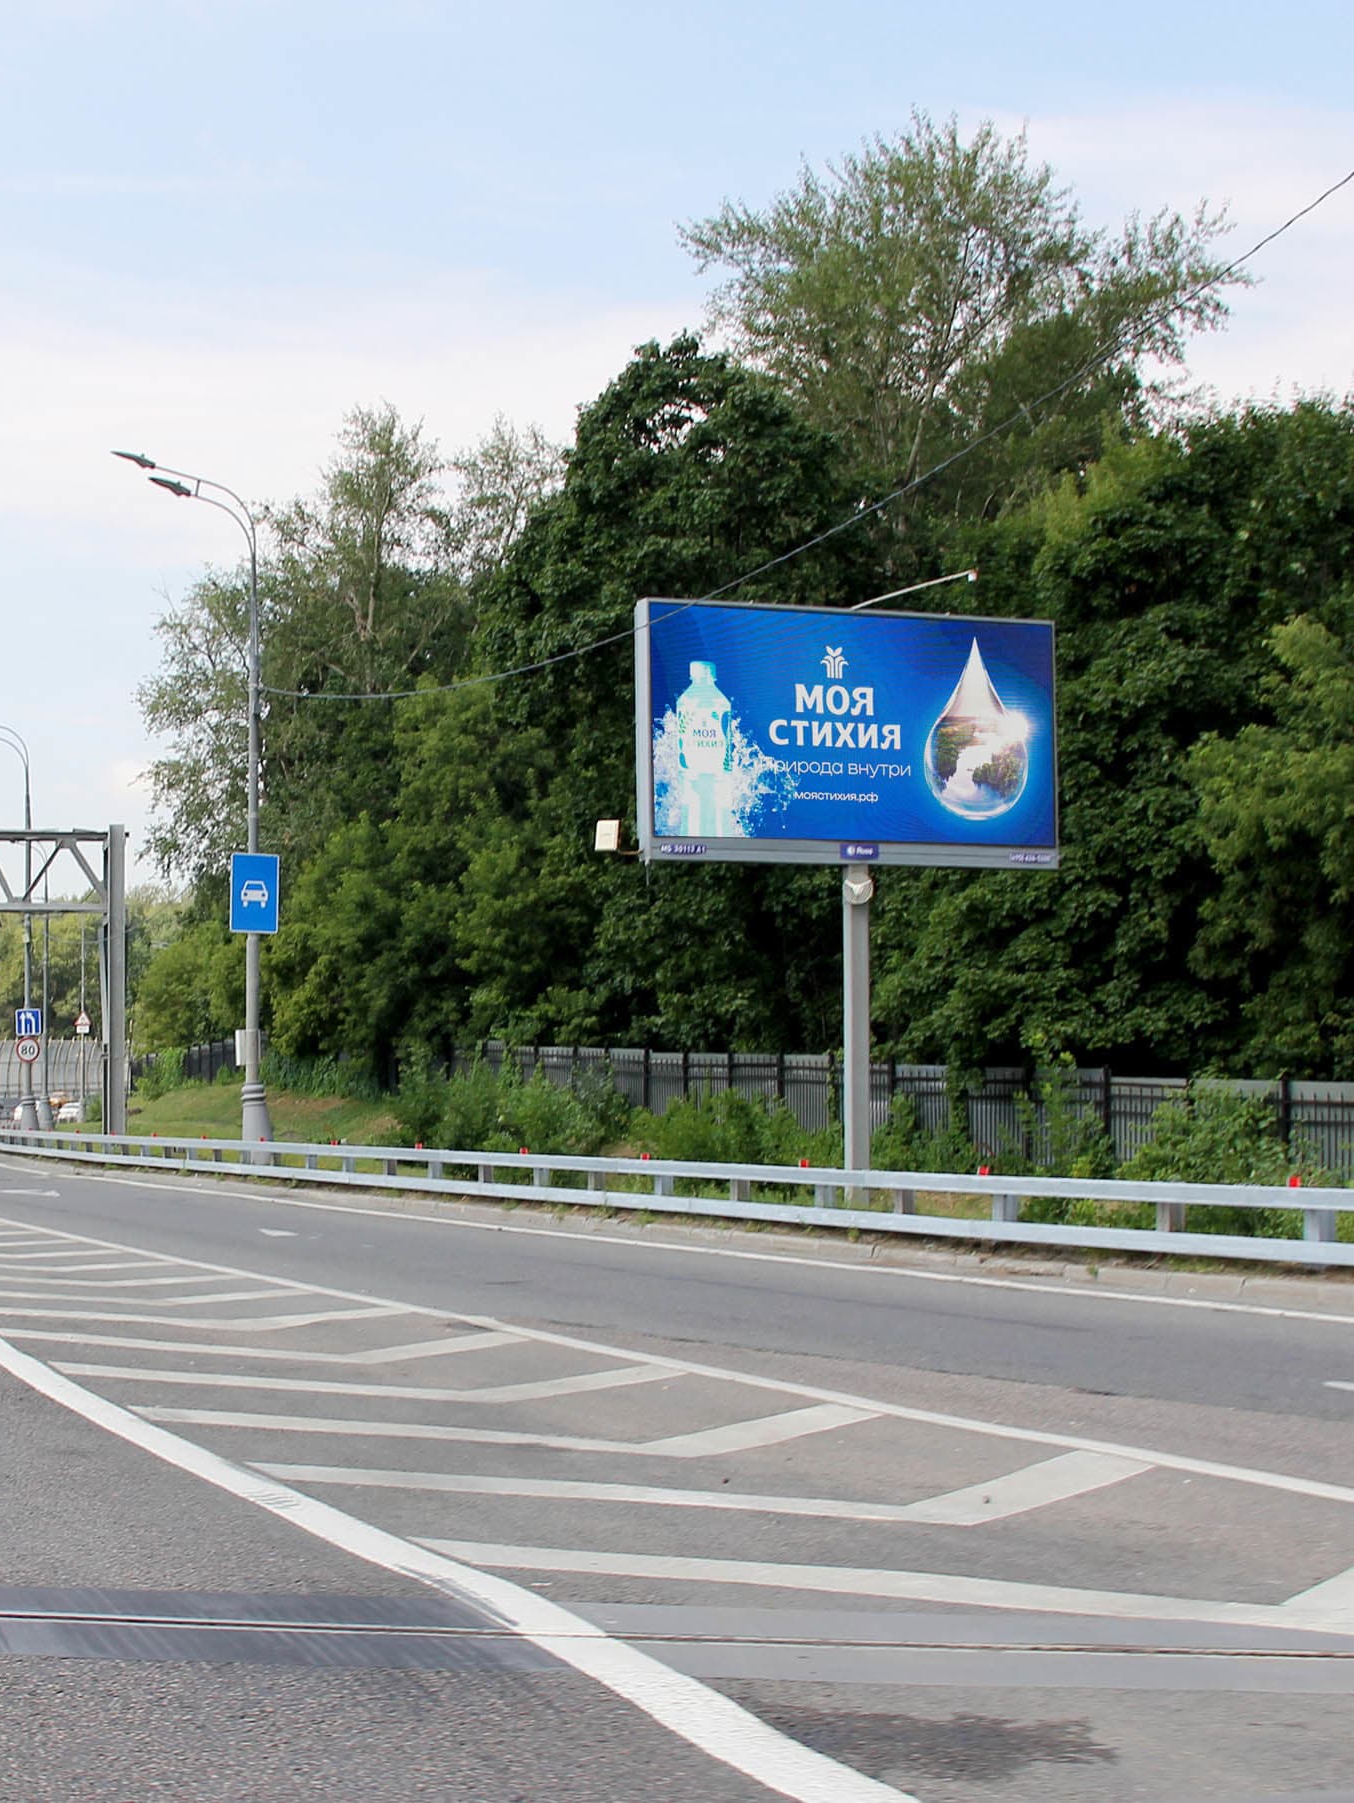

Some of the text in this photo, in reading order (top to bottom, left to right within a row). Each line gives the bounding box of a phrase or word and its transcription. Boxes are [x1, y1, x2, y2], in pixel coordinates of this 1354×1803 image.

[795, 683, 875, 716] МОЯ
[768, 719, 901, 750] СТИХИЯ
[848, 763, 911, 779] внутри
[794, 791, 878, 803] моястихия.рф
[21, 1045, 36, 1055] 80
